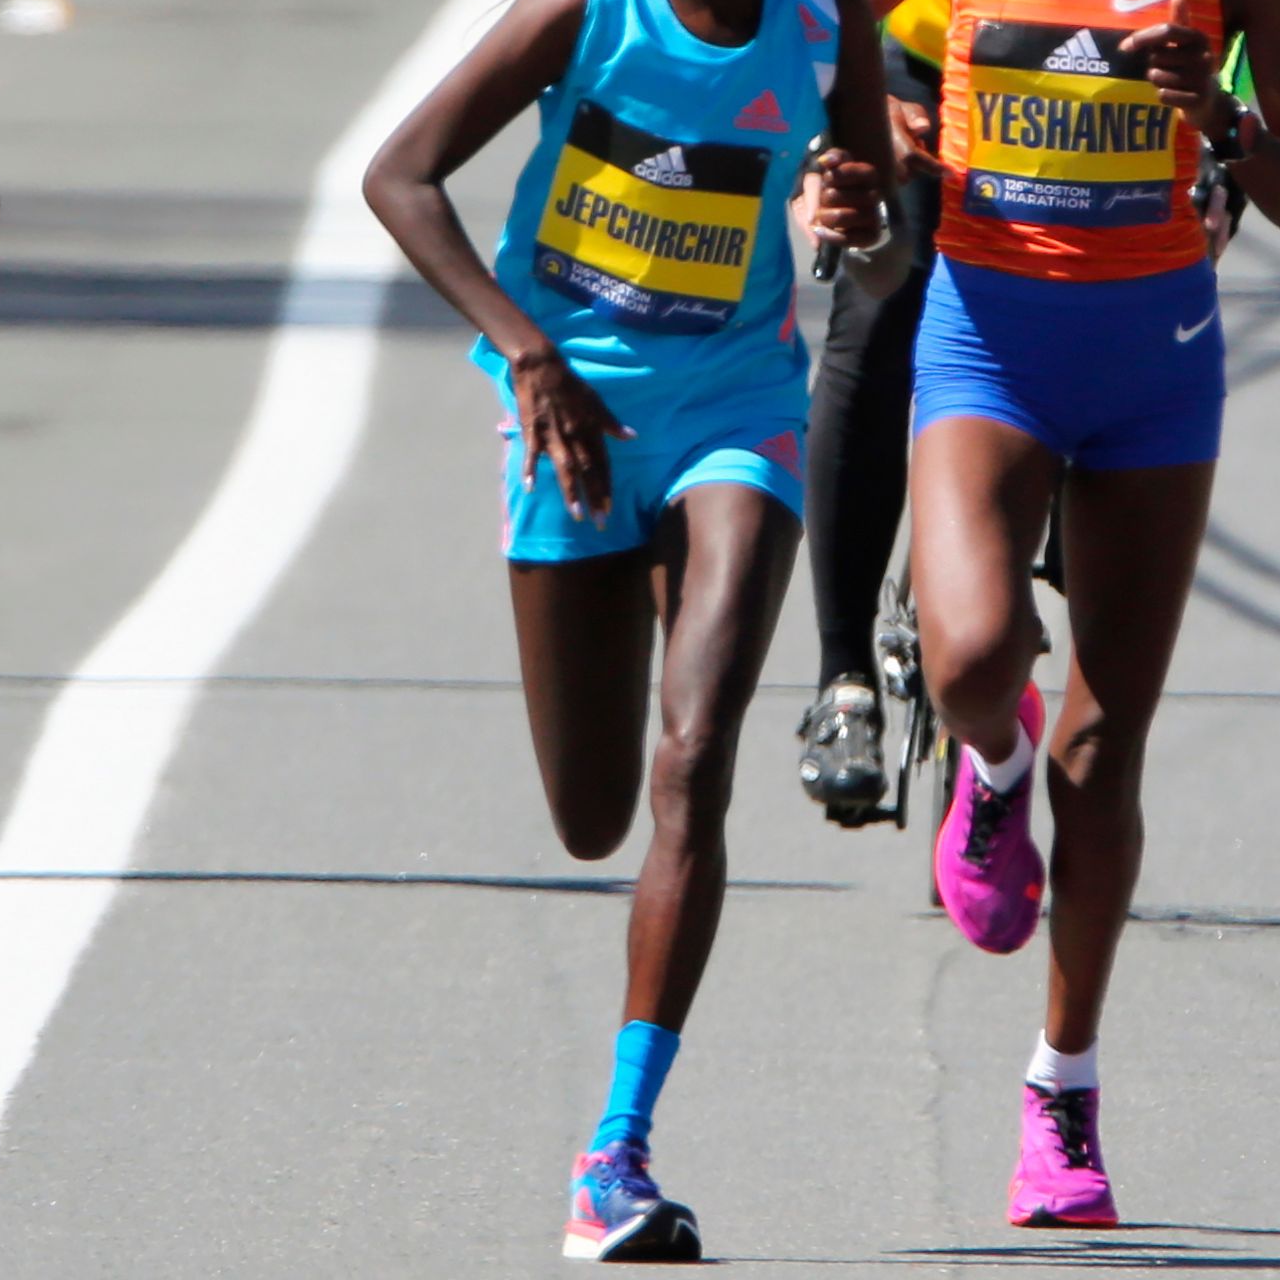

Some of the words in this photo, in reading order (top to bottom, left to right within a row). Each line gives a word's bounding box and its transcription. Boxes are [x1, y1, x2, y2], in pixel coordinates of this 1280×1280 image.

[1045, 54, 1110, 74] adidas
[976, 91, 1170, 153] YESHANEH
[634, 163, 693, 186] adidas
[1004, 191, 1090, 209] MARATHON
[1035, 183, 1090, 197] BOSTON
[556, 183, 748, 266] JEPCHIRCHIR
[568, 274, 649, 314] MARATHON
[600, 275, 651, 303] BOSTON
